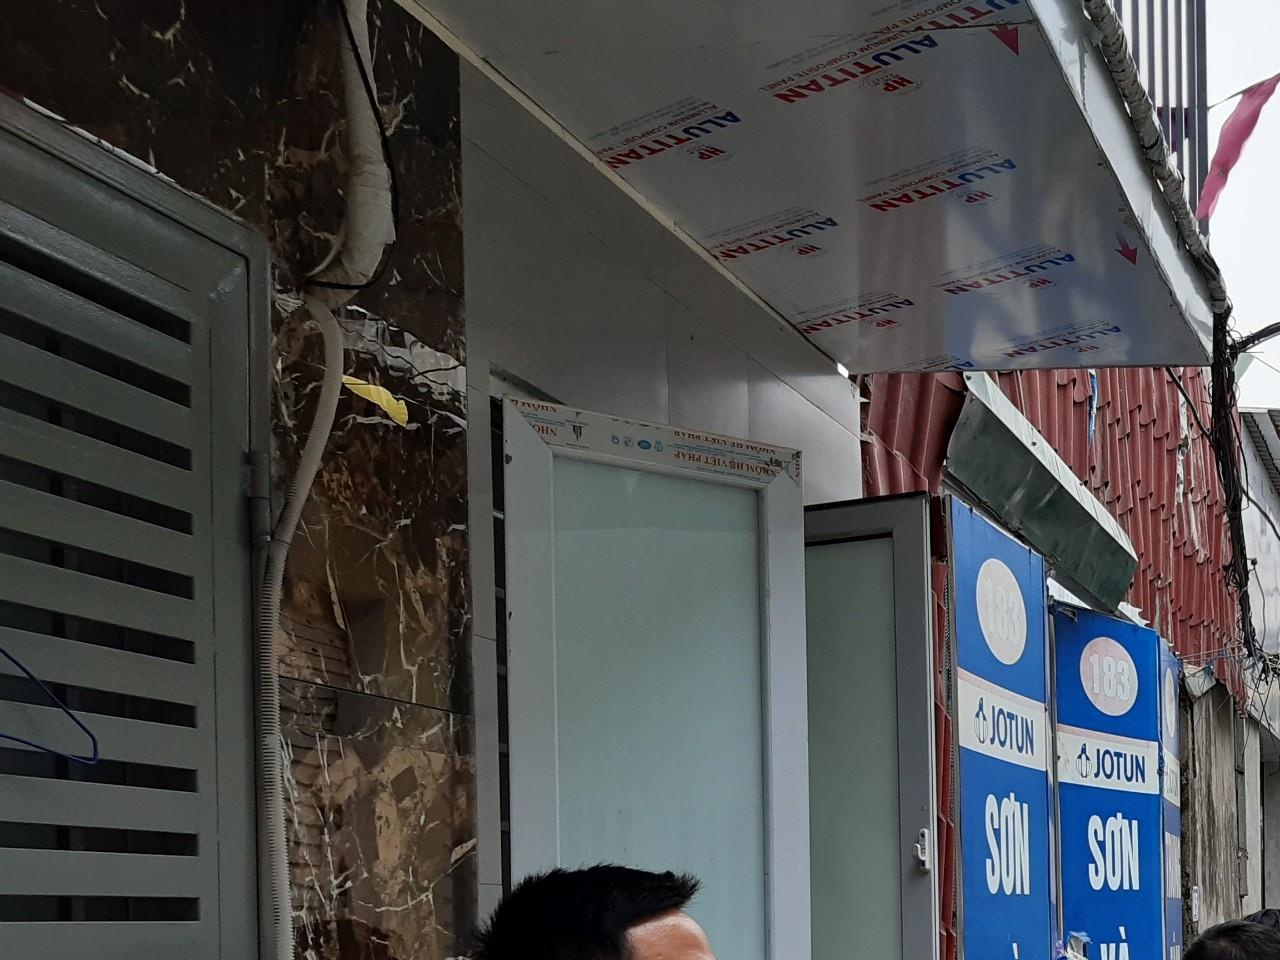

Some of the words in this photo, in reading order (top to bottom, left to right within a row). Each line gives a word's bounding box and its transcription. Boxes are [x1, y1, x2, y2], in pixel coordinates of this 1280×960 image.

[774, 35, 938, 104] ALUTITAN
[606, 111, 742, 170] ALUTITAN
[869, 159, 1016, 213] ALUTITAN
[719, 217, 839, 261] ALUTITAN
[943, 254, 1076, 295] ALUTITAN
[799, 299, 915, 334] ALUTITAN
[1002, 326, 1122, 359] ALUTITAN
[1086, 649, 1131, 696] 183
[990, 704, 1035, 756] JOTUN
[1095, 747, 1146, 784] JOTUN
[984, 792, 1031, 897] SƠN
[1087, 811, 1140, 891] SƠN
